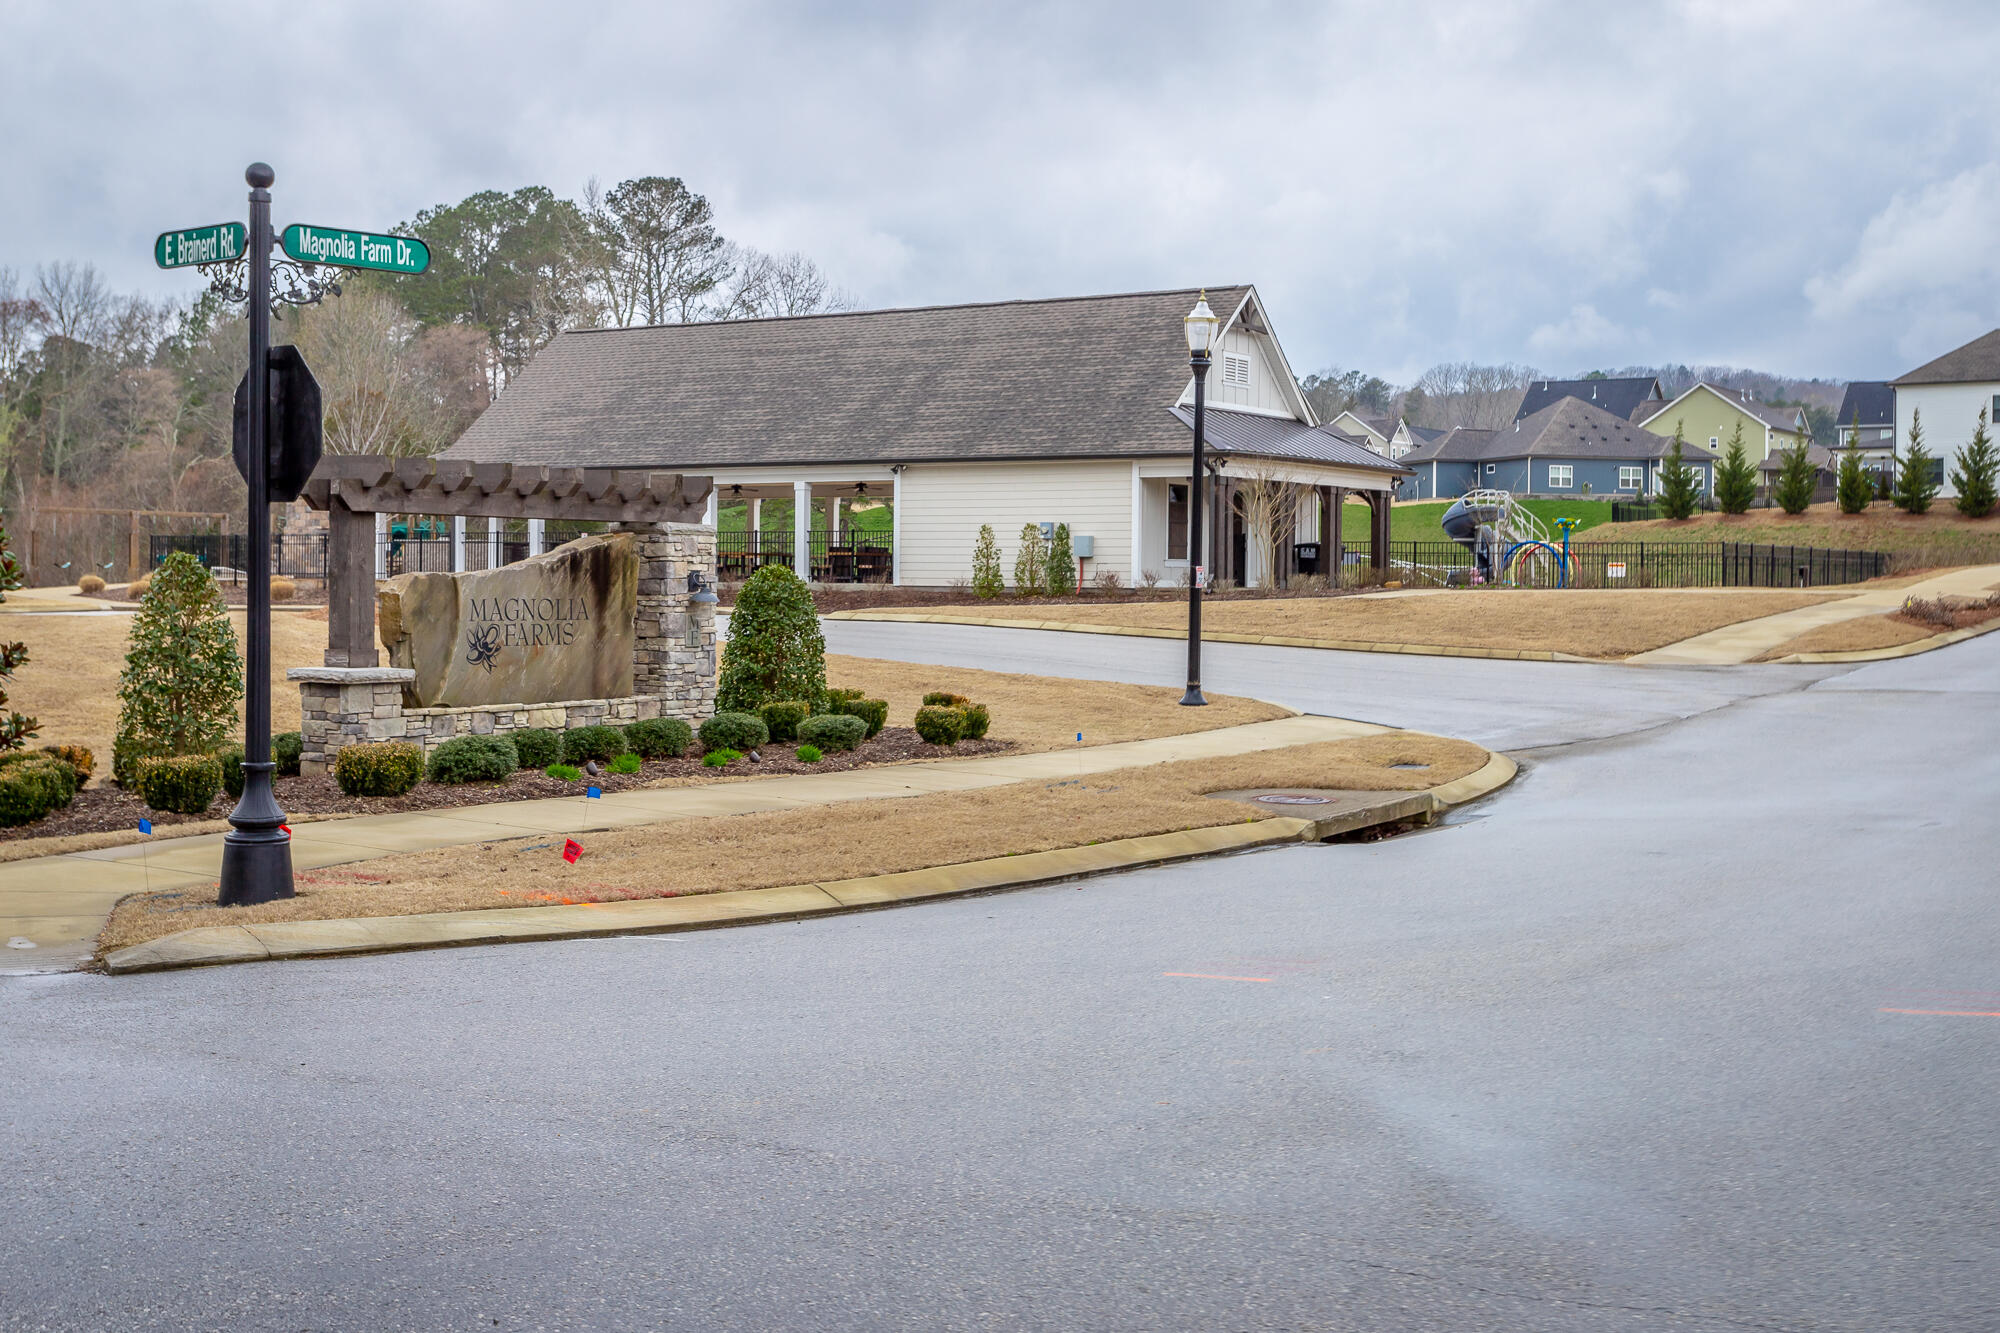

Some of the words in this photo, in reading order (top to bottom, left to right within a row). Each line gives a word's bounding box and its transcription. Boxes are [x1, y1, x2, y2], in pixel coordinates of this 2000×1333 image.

[165, 235, 175, 265] E.
[177, 229, 217, 264] Brainerd
[220, 227, 236, 257] Rd.
[299, 227, 355, 261] Magnolia
[361, 235, 391, 263] Farm
[397, 240, 415, 267] Dr.
[470, 597, 589, 621] MAGNOLIA
[504, 623, 574, 646] FARMS
